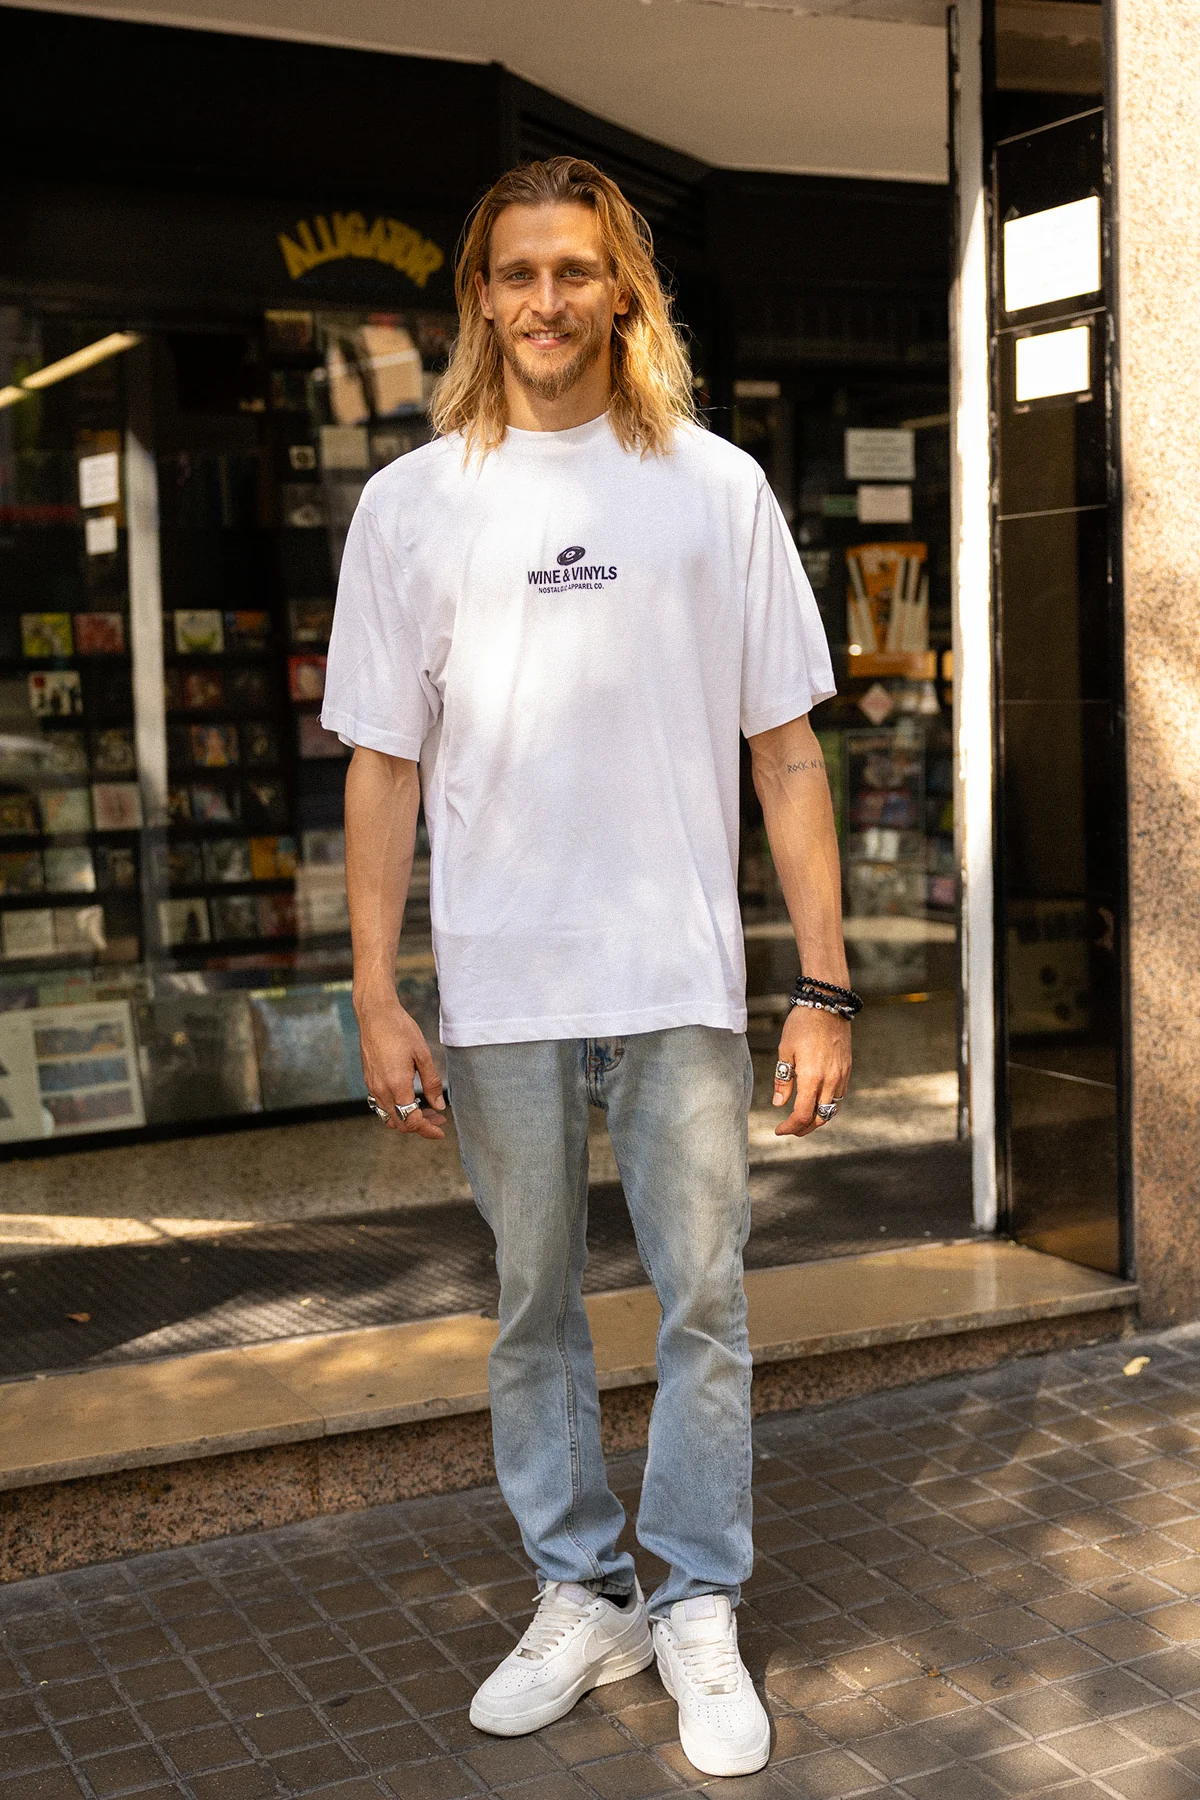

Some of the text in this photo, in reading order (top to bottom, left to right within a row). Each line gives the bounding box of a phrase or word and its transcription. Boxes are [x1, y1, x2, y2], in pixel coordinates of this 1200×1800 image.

[277, 210, 445, 288] ALLIGATOR
[527, 565, 618, 585] WINE & VINYLS
[538, 582, 605, 594] NOSTALGC APPAREL CO.
[787, 759, 810, 774] ROCK
